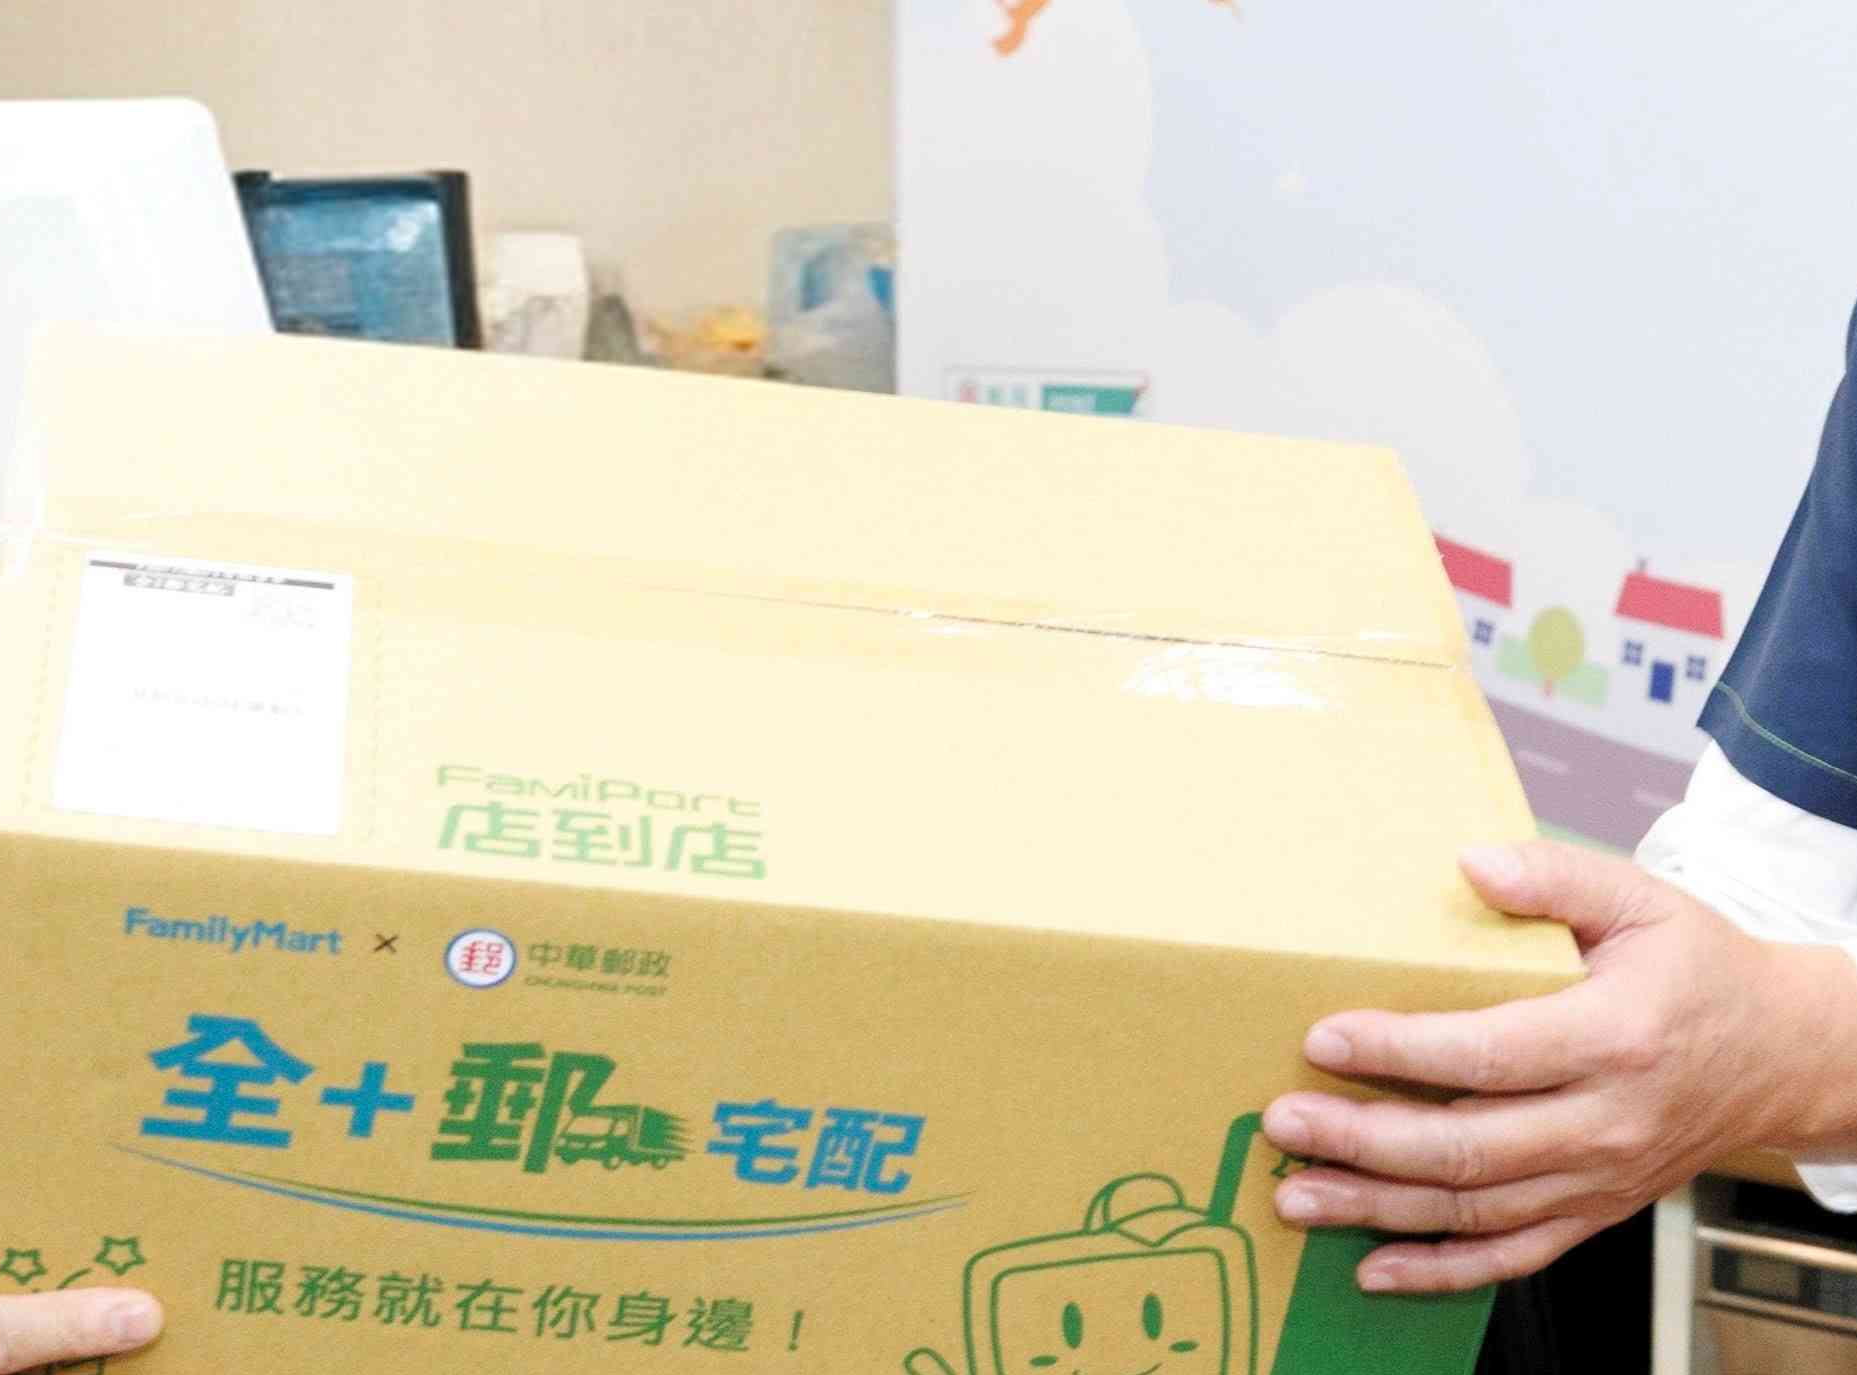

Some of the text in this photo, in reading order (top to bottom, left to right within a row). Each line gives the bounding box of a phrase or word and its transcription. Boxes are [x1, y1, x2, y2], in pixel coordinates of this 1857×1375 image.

[436, 763, 762, 819] FamiPort
[436, 798, 768, 881] 店到店
[123, 905, 342, 955] FamilyMart
[527, 940, 672, 978] 中華郵政
